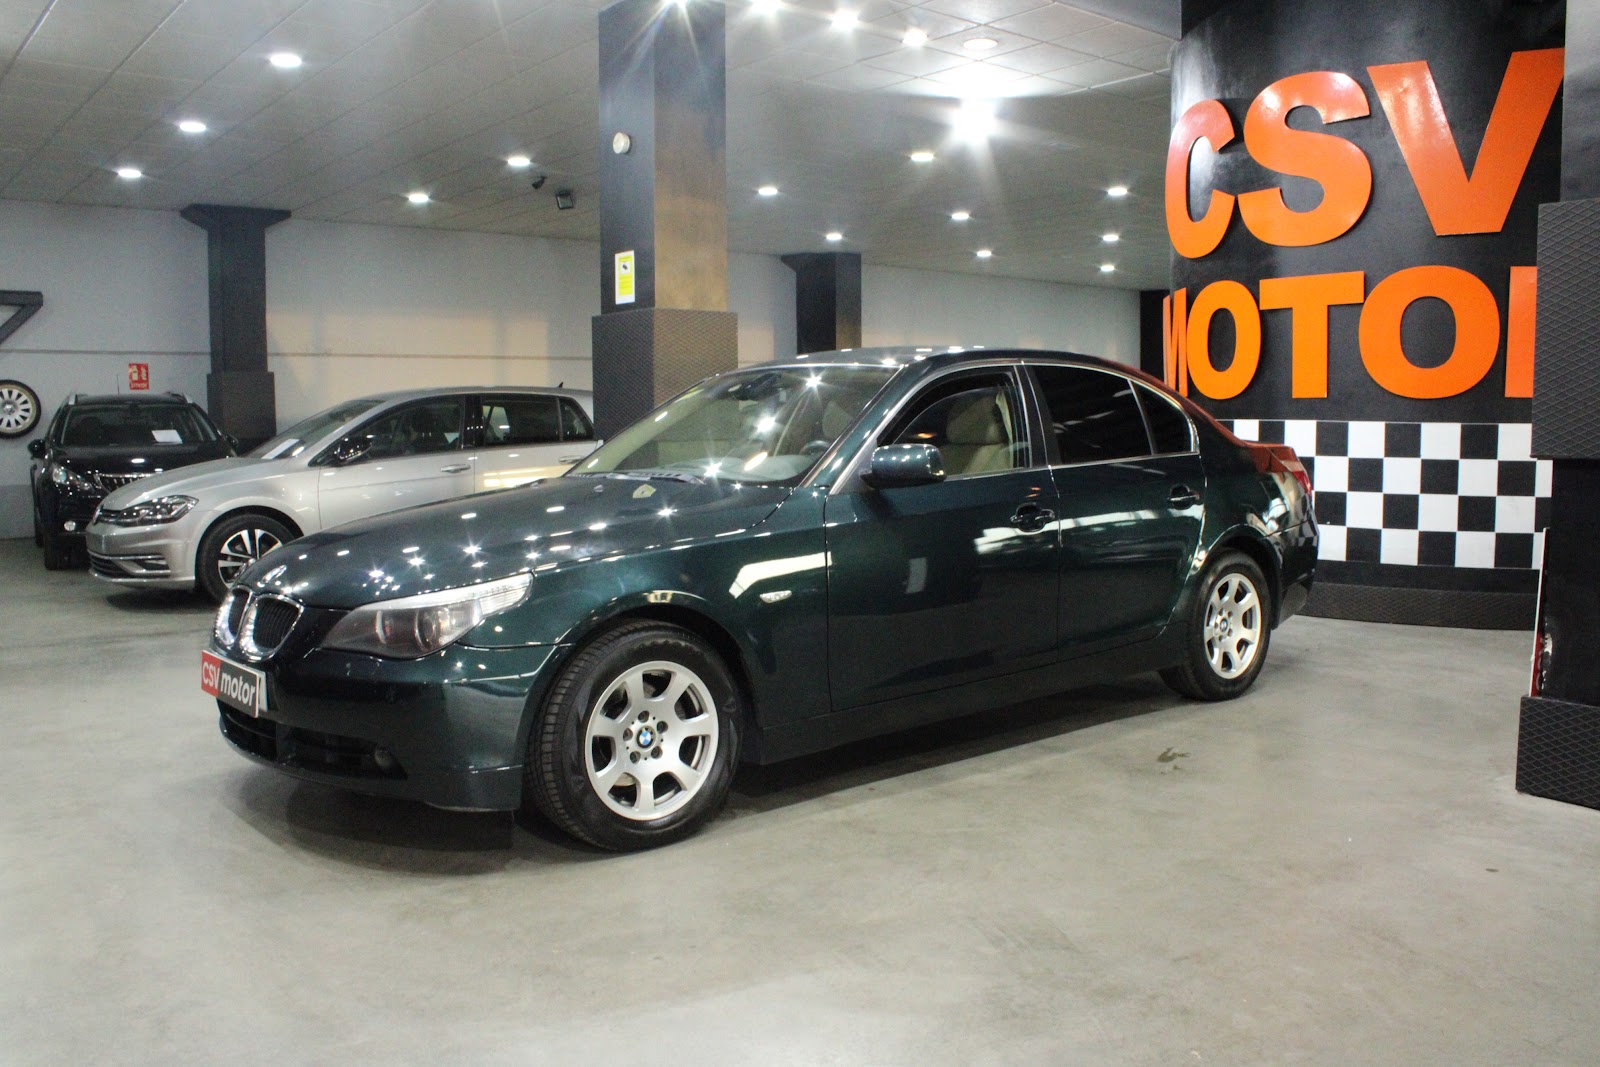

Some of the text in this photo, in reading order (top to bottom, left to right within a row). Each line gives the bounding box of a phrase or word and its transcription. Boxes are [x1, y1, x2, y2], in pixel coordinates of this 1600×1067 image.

[1165, 47, 1564, 259] CSV
[202, 662, 255, 706] CSV motor
